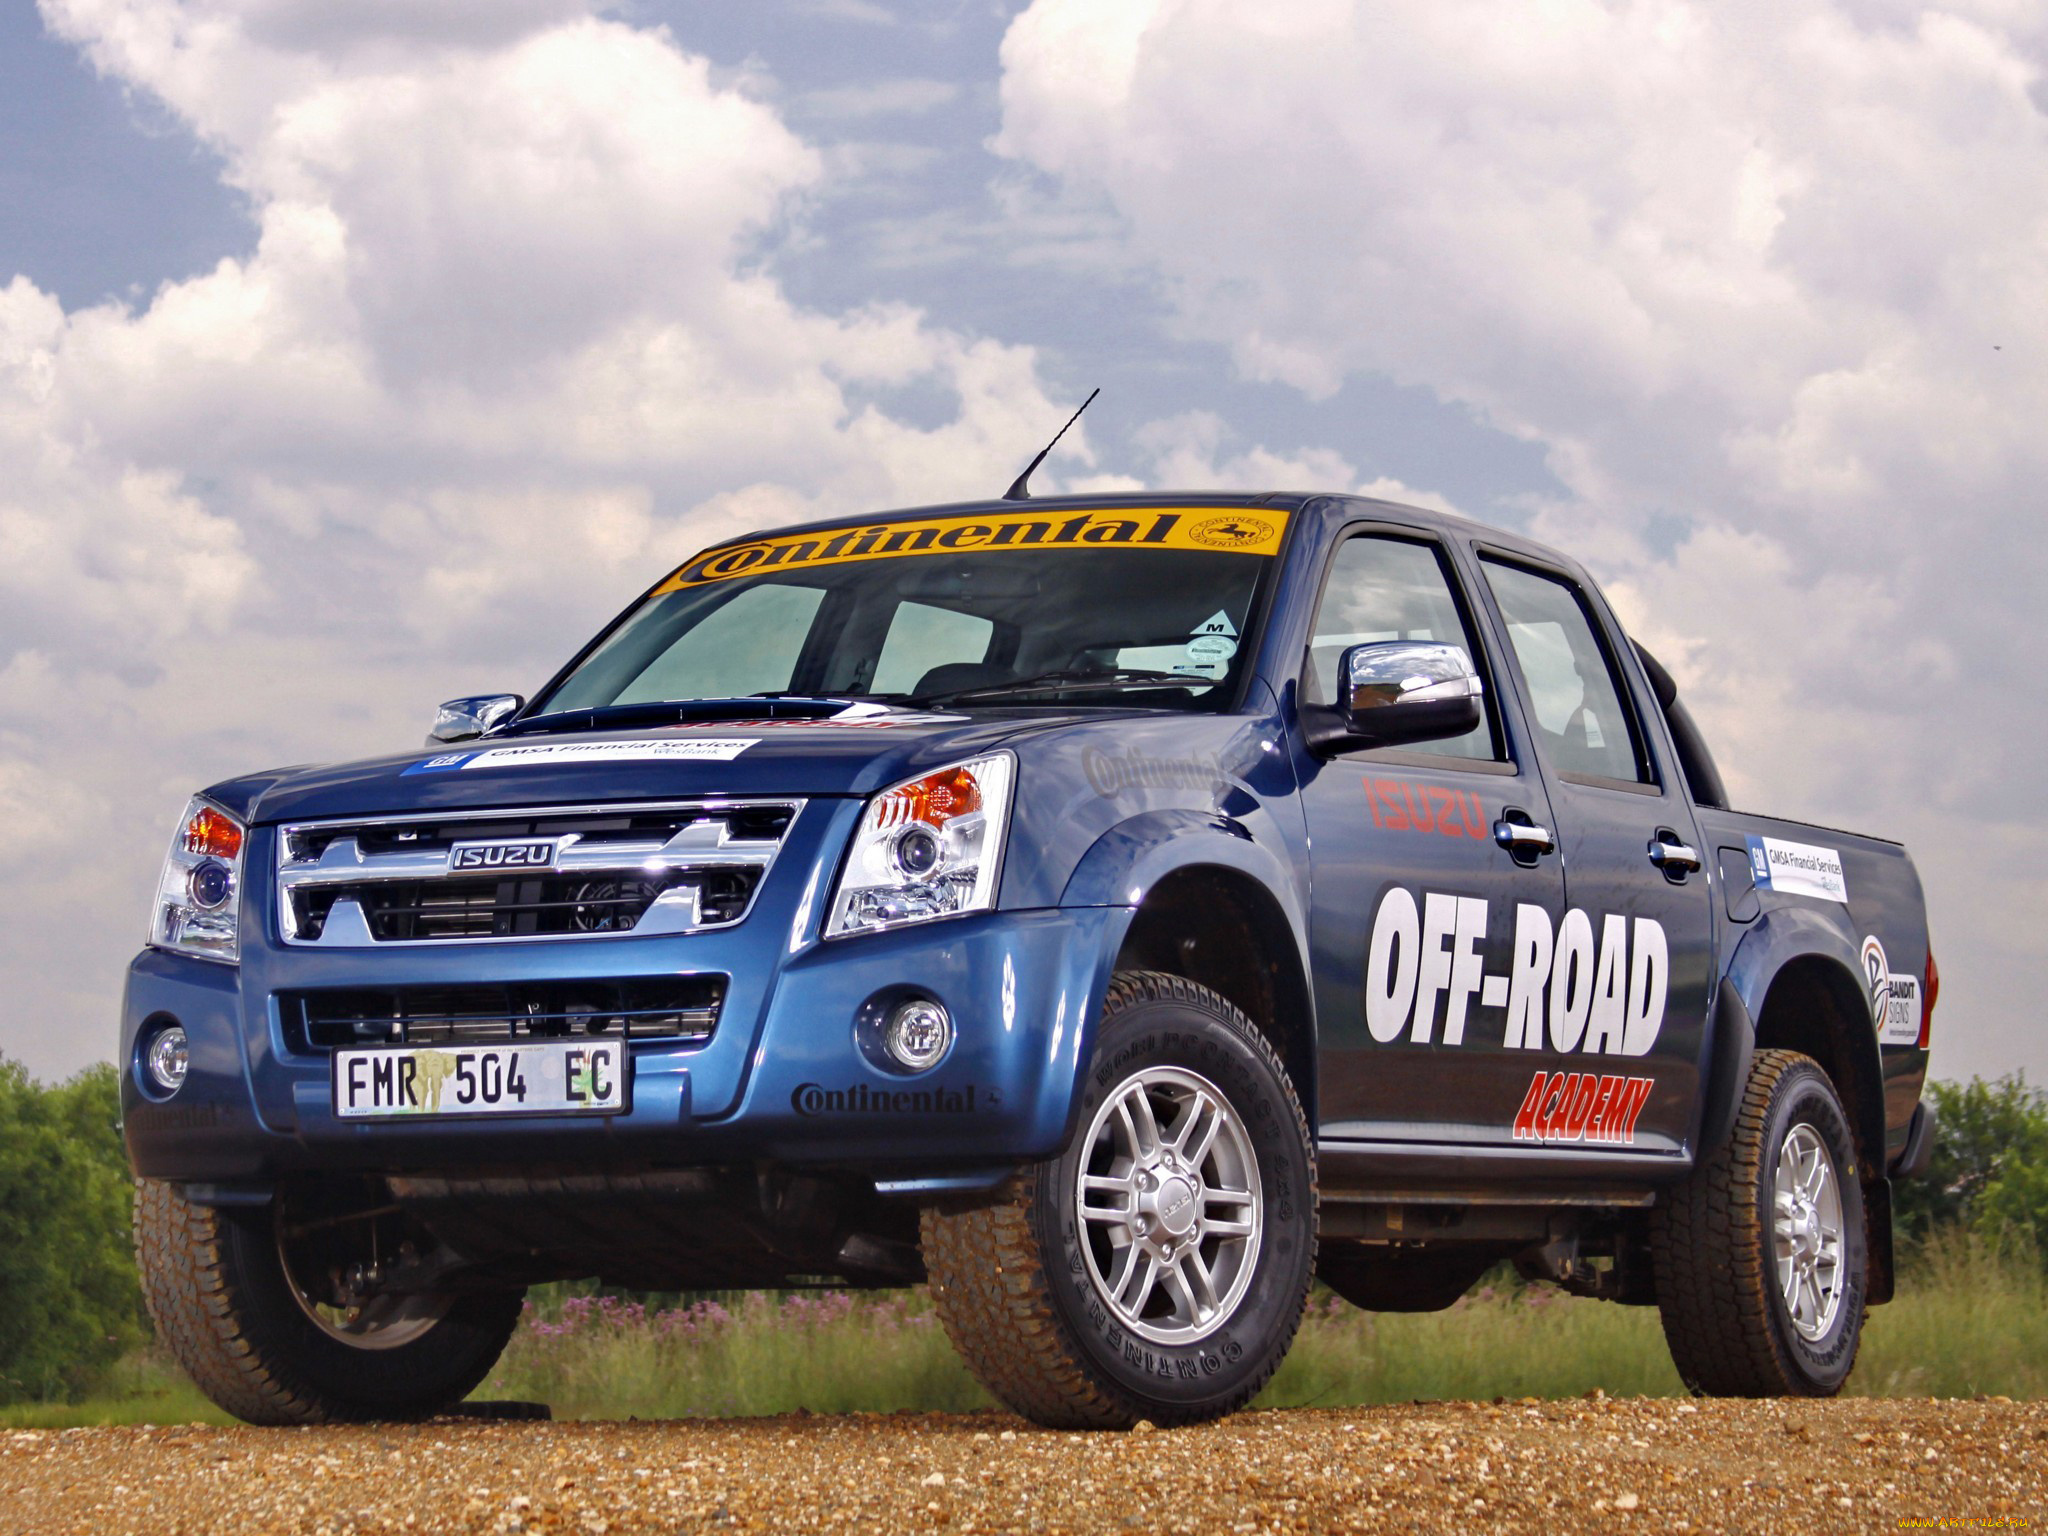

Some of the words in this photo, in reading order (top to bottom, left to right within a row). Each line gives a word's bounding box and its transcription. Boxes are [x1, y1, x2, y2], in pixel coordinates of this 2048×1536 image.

[680, 514, 1182, 583] Continental
[1205, 624, 1225, 633] M
[427, 754, 469, 767] GM
[490, 747, 553, 757] GMSA
[558, 742, 657, 753] Financial
[1081, 744, 1223, 799] Continental
[1361, 777, 1488, 840] ISUZU
[454, 845, 549, 867] ISUZU
[1752, 847, 1767, 871] GM
[1769, 849, 1790, 867] GMSA
[1789, 852, 1818, 872] Financial
[1816, 858, 1842, 875] Services
[1365, 887, 1669, 1057] OFF-ROAD
[1889, 981, 1915, 999] BANDIT
[1889, 1001, 1909, 1024] SIGNS
[348, 1056, 418, 1108] FMR
[456, 1052, 527, 1105] 504
[565, 1050, 613, 1101] EC
[790, 1082, 977, 1117] Continental
[1512, 1071, 1654, 1144] ACADEMY
